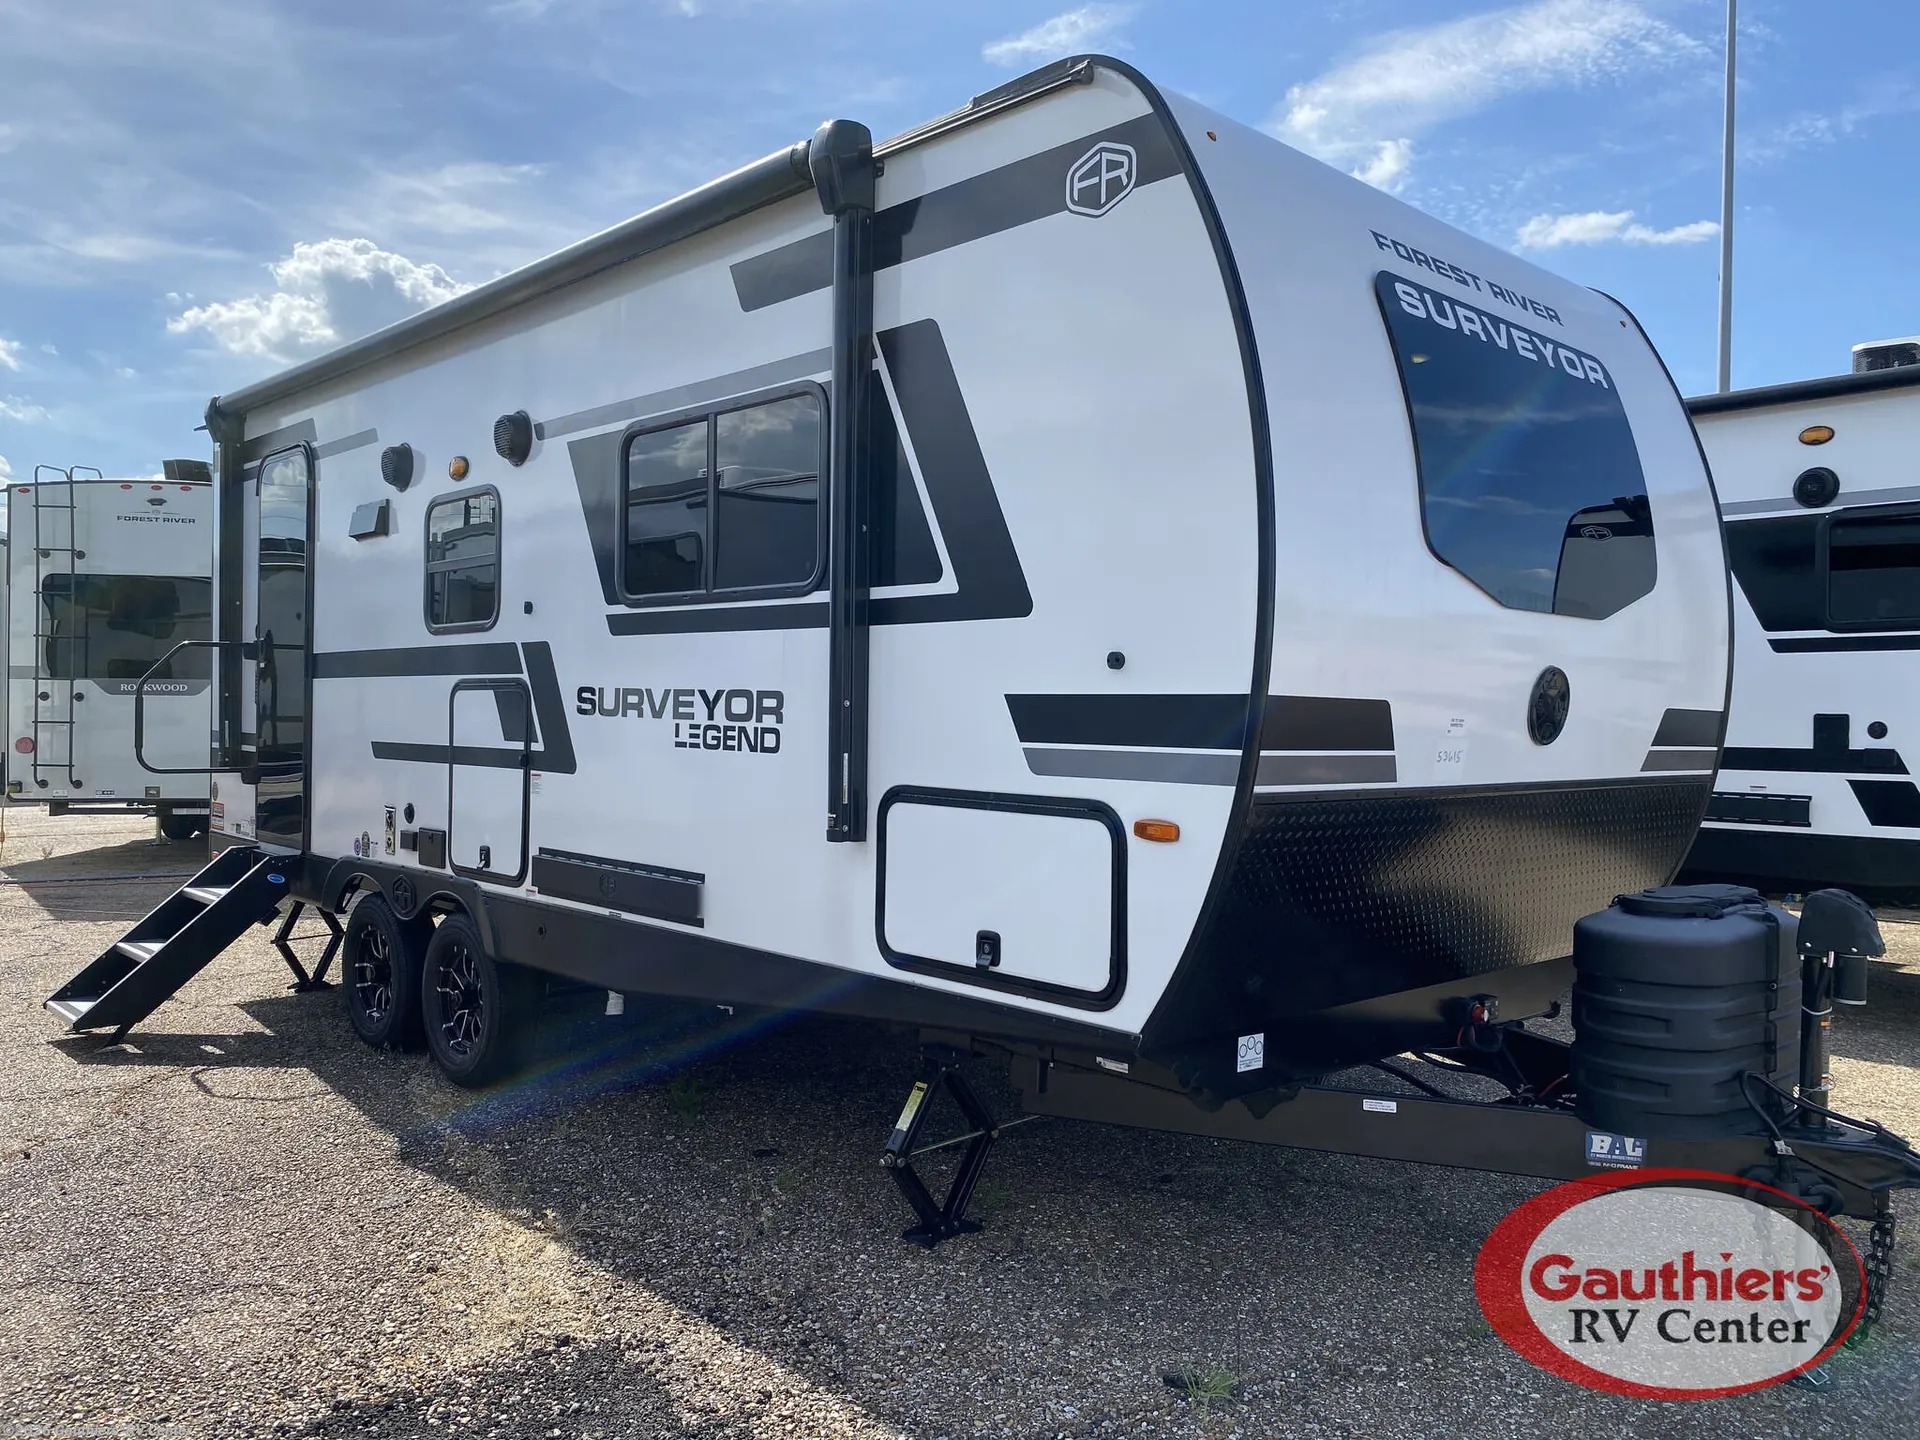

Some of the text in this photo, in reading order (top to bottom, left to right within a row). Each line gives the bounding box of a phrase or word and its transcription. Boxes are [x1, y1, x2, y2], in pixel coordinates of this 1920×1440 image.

[1369, 229, 1565, 327] FOREST RIVER
[1394, 282, 1609, 389] SURVEYOR
[116, 515, 160, 523] FOREST
[120, 683, 188, 691] ROKWOOD
[576, 686, 785, 724] SURVEYOR
[674, 723, 781, 754] LEGEND
[1590, 1134, 1643, 1156] BAL
